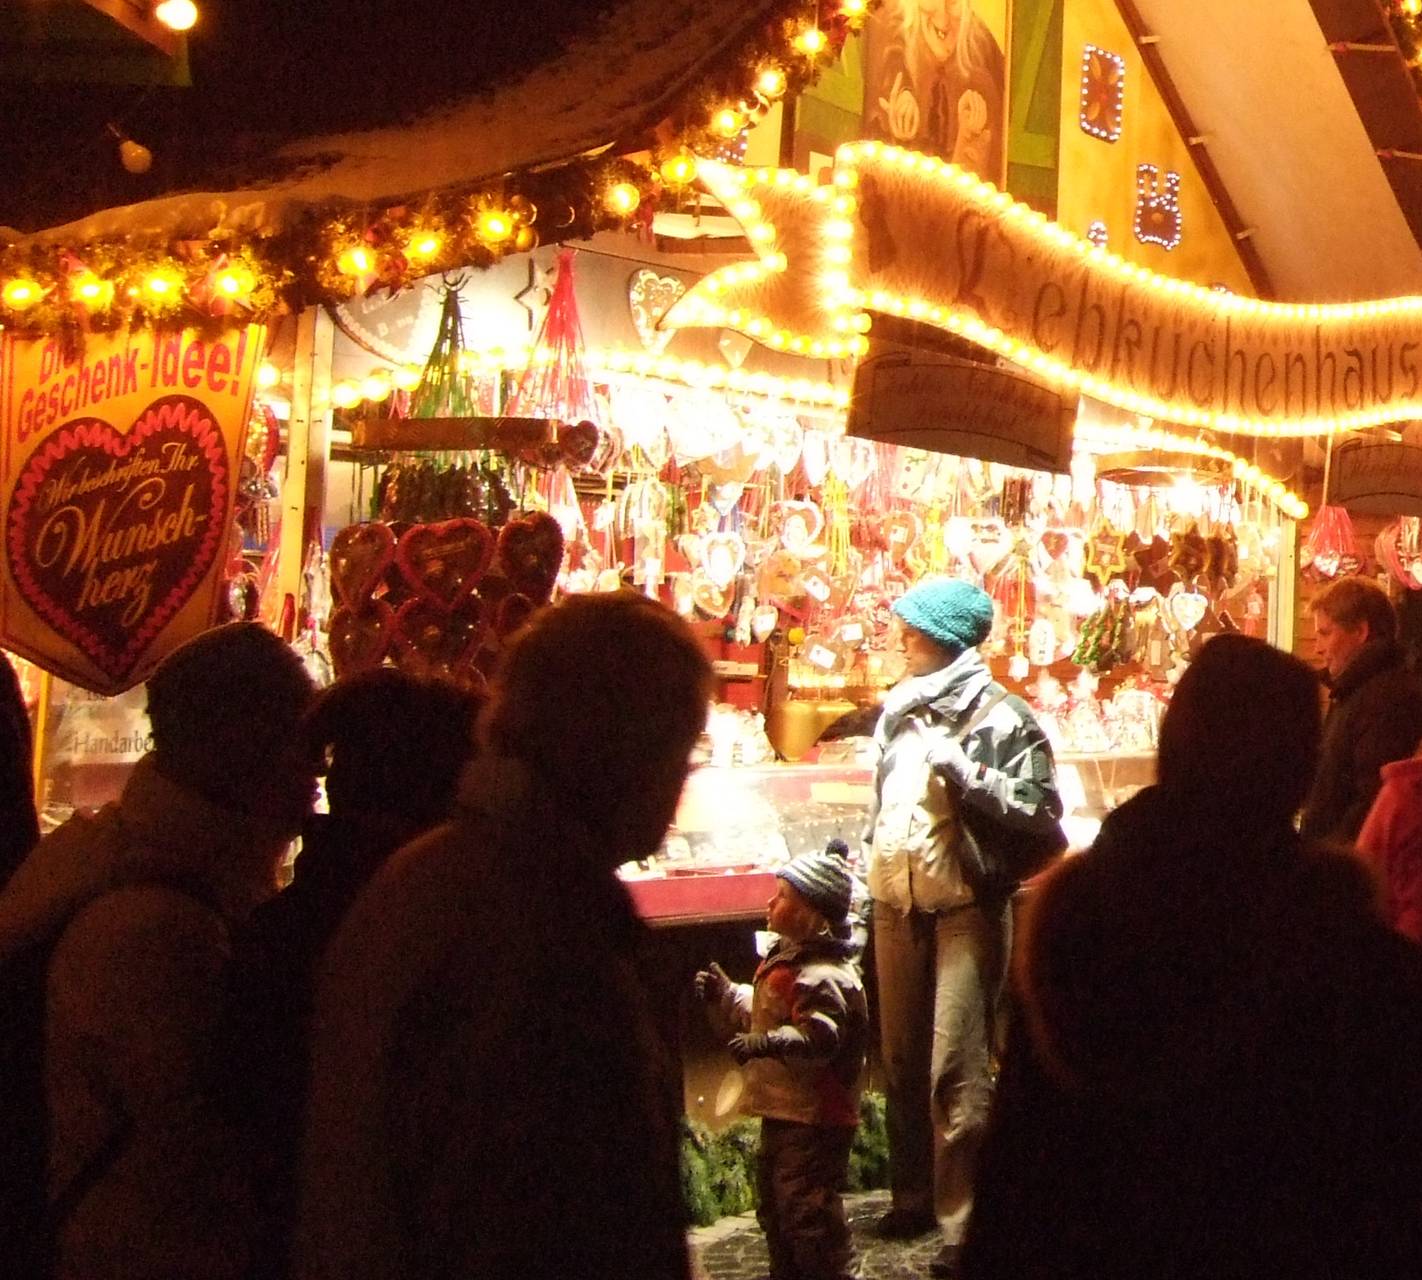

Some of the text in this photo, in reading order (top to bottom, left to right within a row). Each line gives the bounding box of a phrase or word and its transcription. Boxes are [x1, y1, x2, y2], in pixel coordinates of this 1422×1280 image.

[16, 330, 247, 443] Geschenk-Idee!
[156, 442, 199, 474] Ihr
[35, 477, 208, 577] Wunsch-
[74, 558, 157, 627] herz
[73, 731, 156, 753] Handarbe
